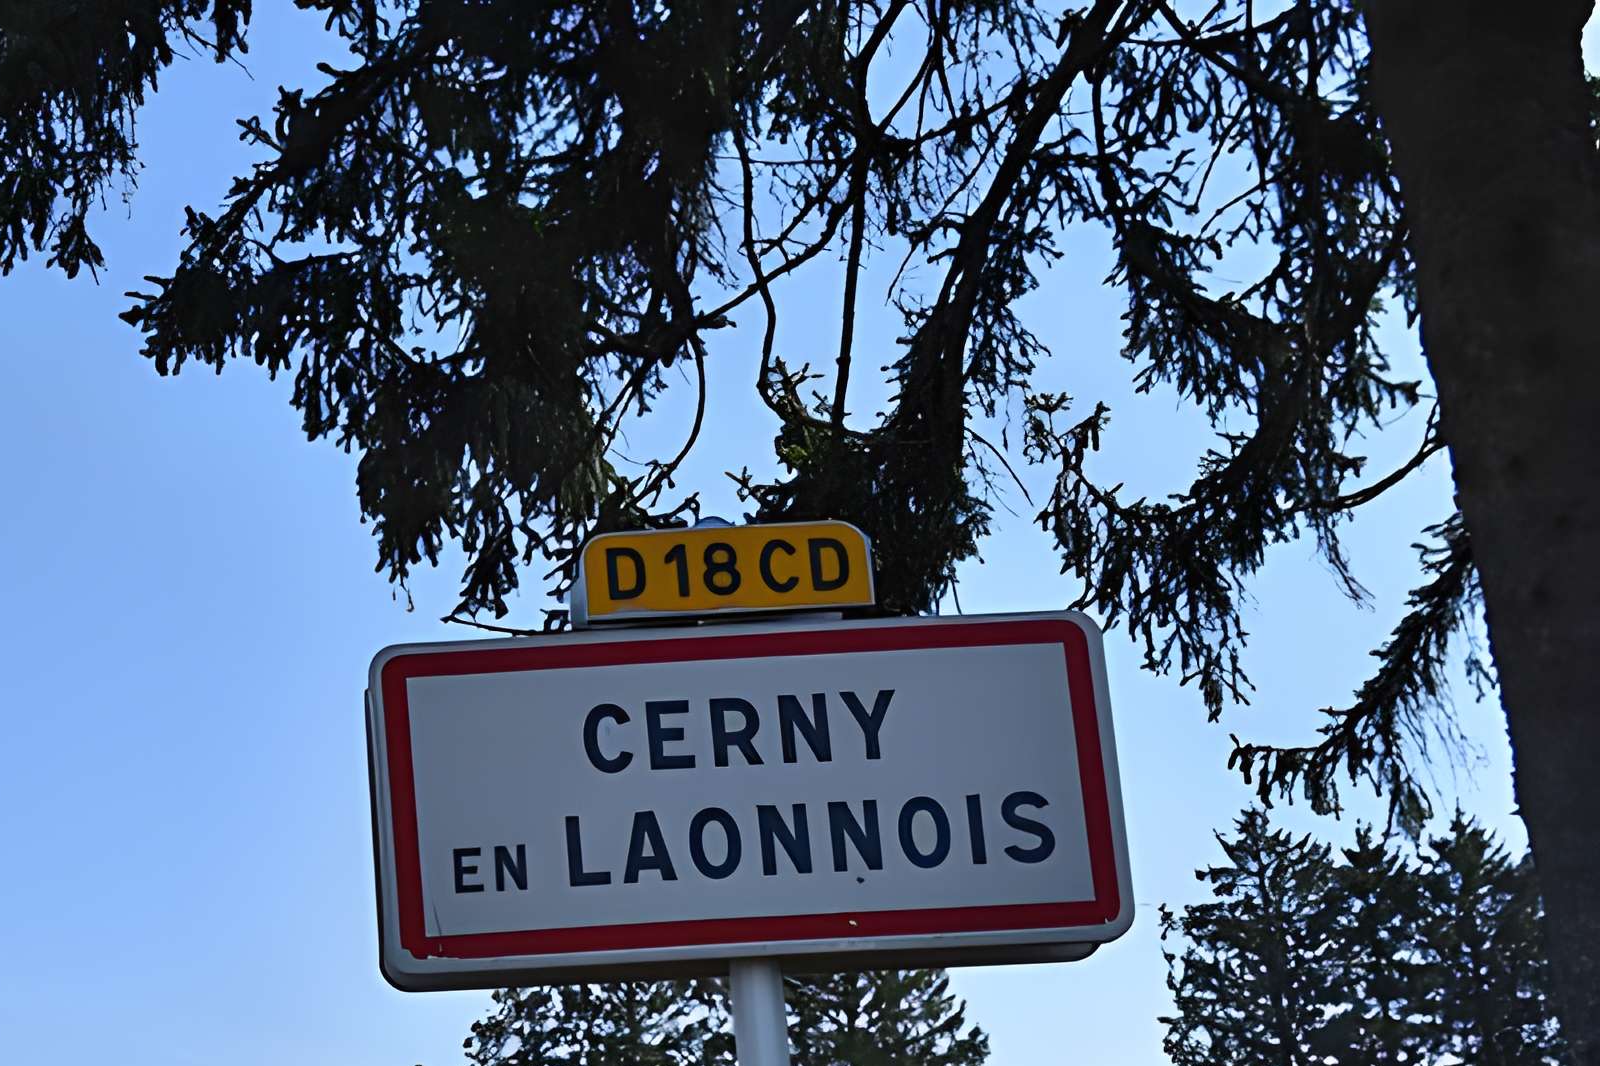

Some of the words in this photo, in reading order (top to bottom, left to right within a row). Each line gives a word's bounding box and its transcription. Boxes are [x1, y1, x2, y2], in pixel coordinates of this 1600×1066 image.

[583, 689, 896, 774] CERNY
[453, 843, 529, 894] EN
[564, 791, 1057, 888] LAONNOIS
